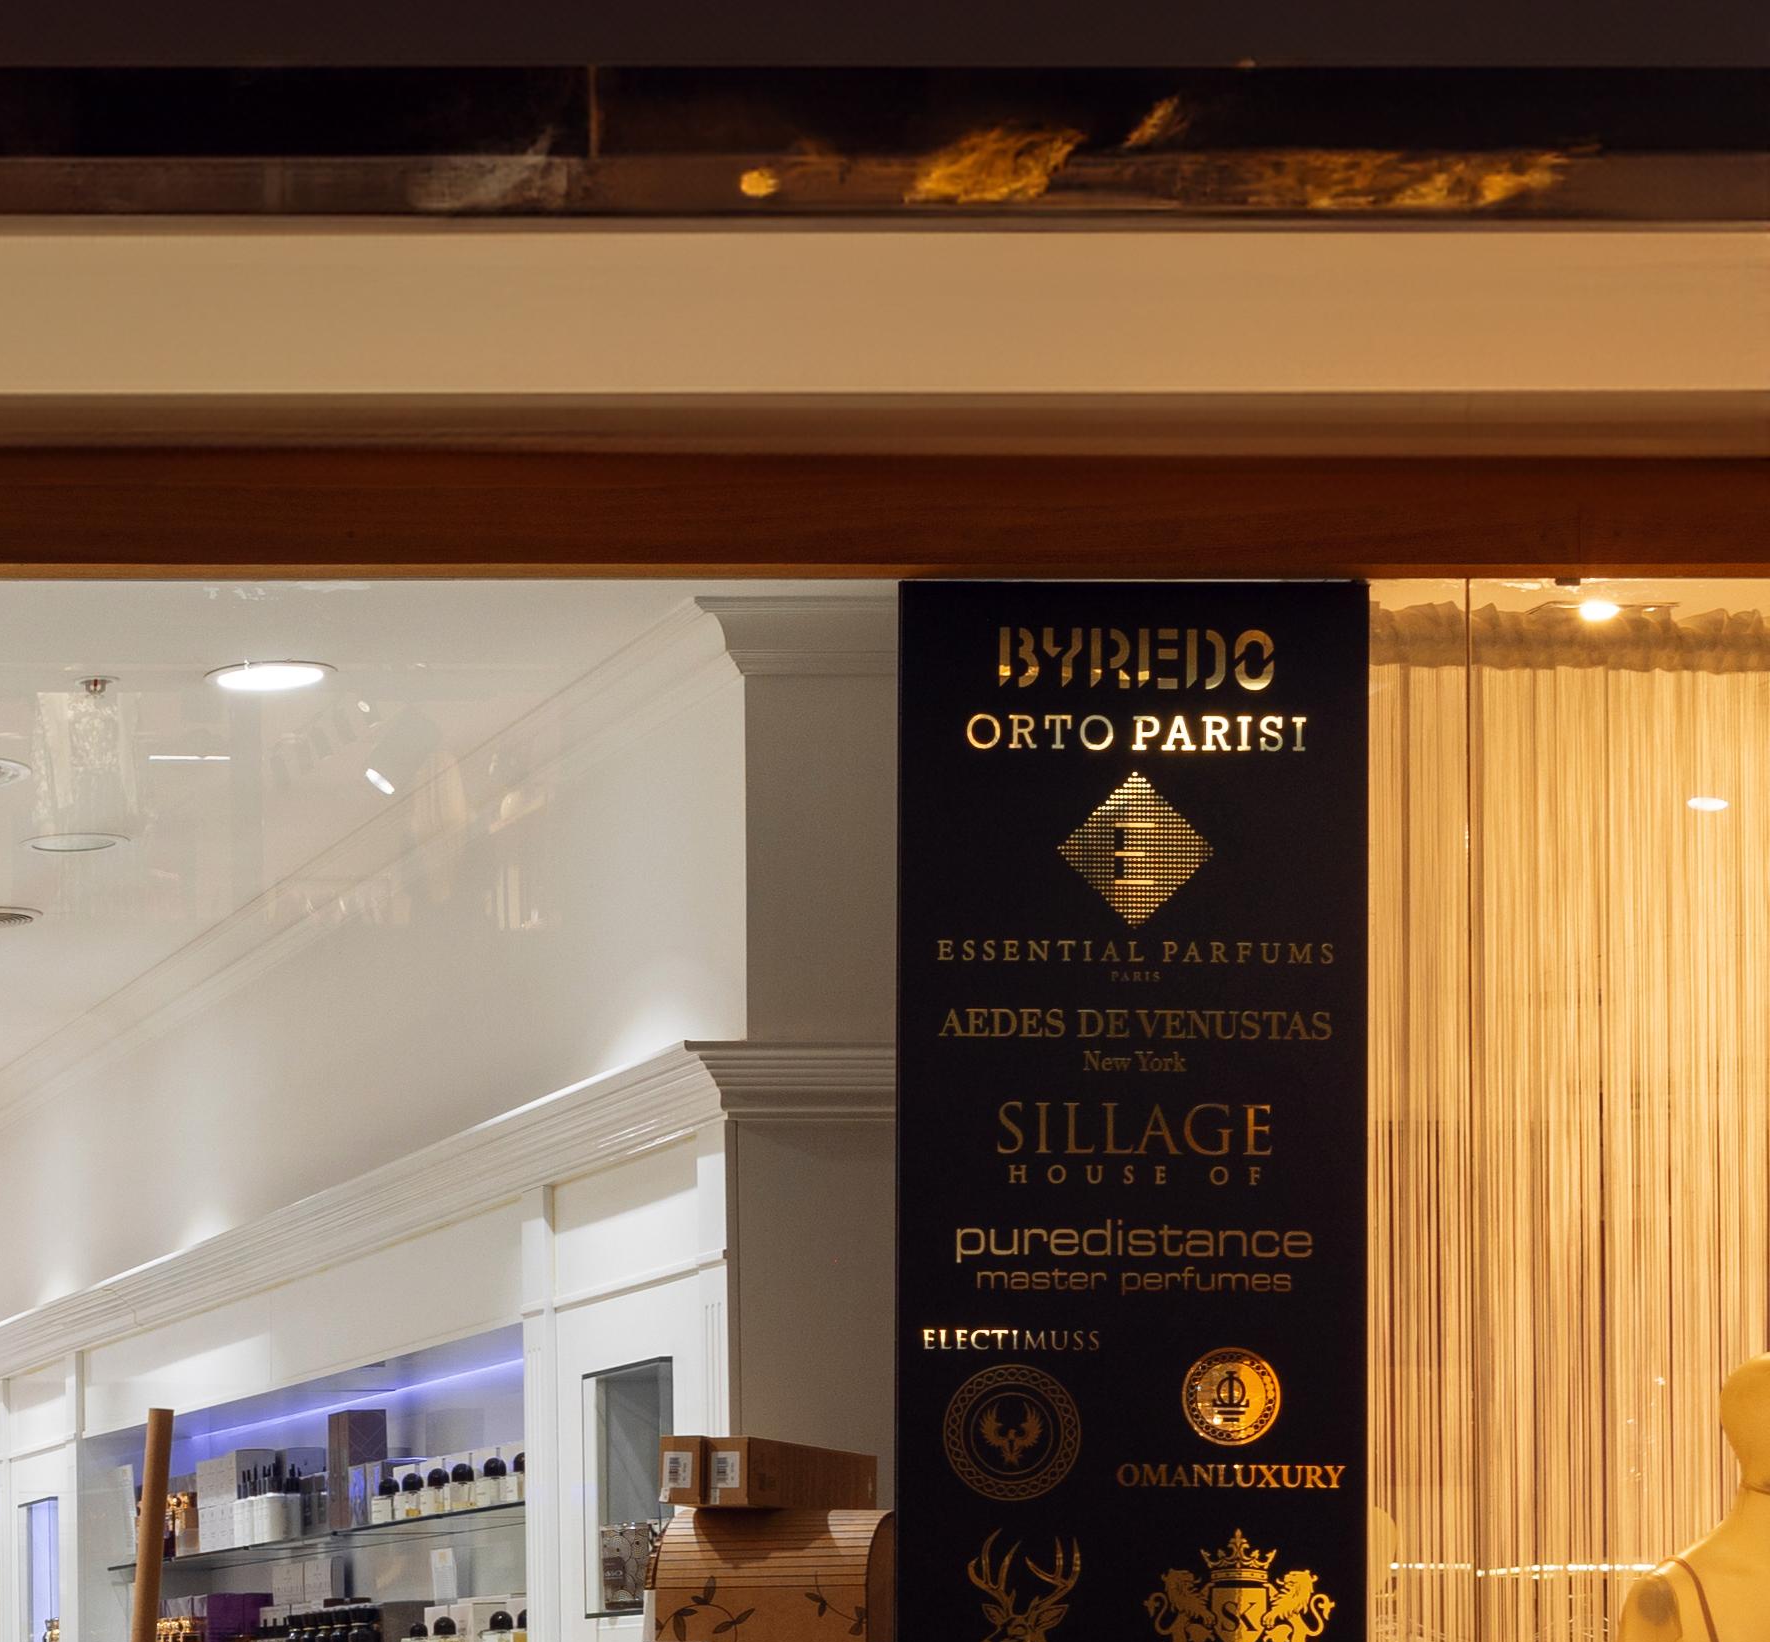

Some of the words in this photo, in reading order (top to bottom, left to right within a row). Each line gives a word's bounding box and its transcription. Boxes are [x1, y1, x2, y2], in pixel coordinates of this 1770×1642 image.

[999, 627, 1275, 690] BYREDO
[966, 713, 1114, 750] ORTO
[1132, 715, 1307, 752] PARISI
[937, 939, 1145, 963] ESSENTIAL
[1163, 941, 1335, 965] PARFUMS
[1111, 971, 1161, 982] PARIS
[939, 1007, 1066, 1039] AEDES
[1077, 1009, 1129, 1039] DE
[1134, 1009, 1333, 1041] VENUSTAS
[1083, 1051, 1131, 1073] New
[1136, 1051, 1186, 1073] York
[997, 1101, 1273, 1156] SILLAGE
[1009, 1165, 1167, 1184] HOUSE
[1210, 1166, 1262, 1186] OF
[956, 1219, 1313, 1263] puredistance
[976, 1268, 1107, 1291] master
[1121, 1266, 1292, 1295] perfumes
[922, 1329, 1101, 1351] ELECTIMUSS
[1116, 1463, 1347, 1489] OMANLUXURY
